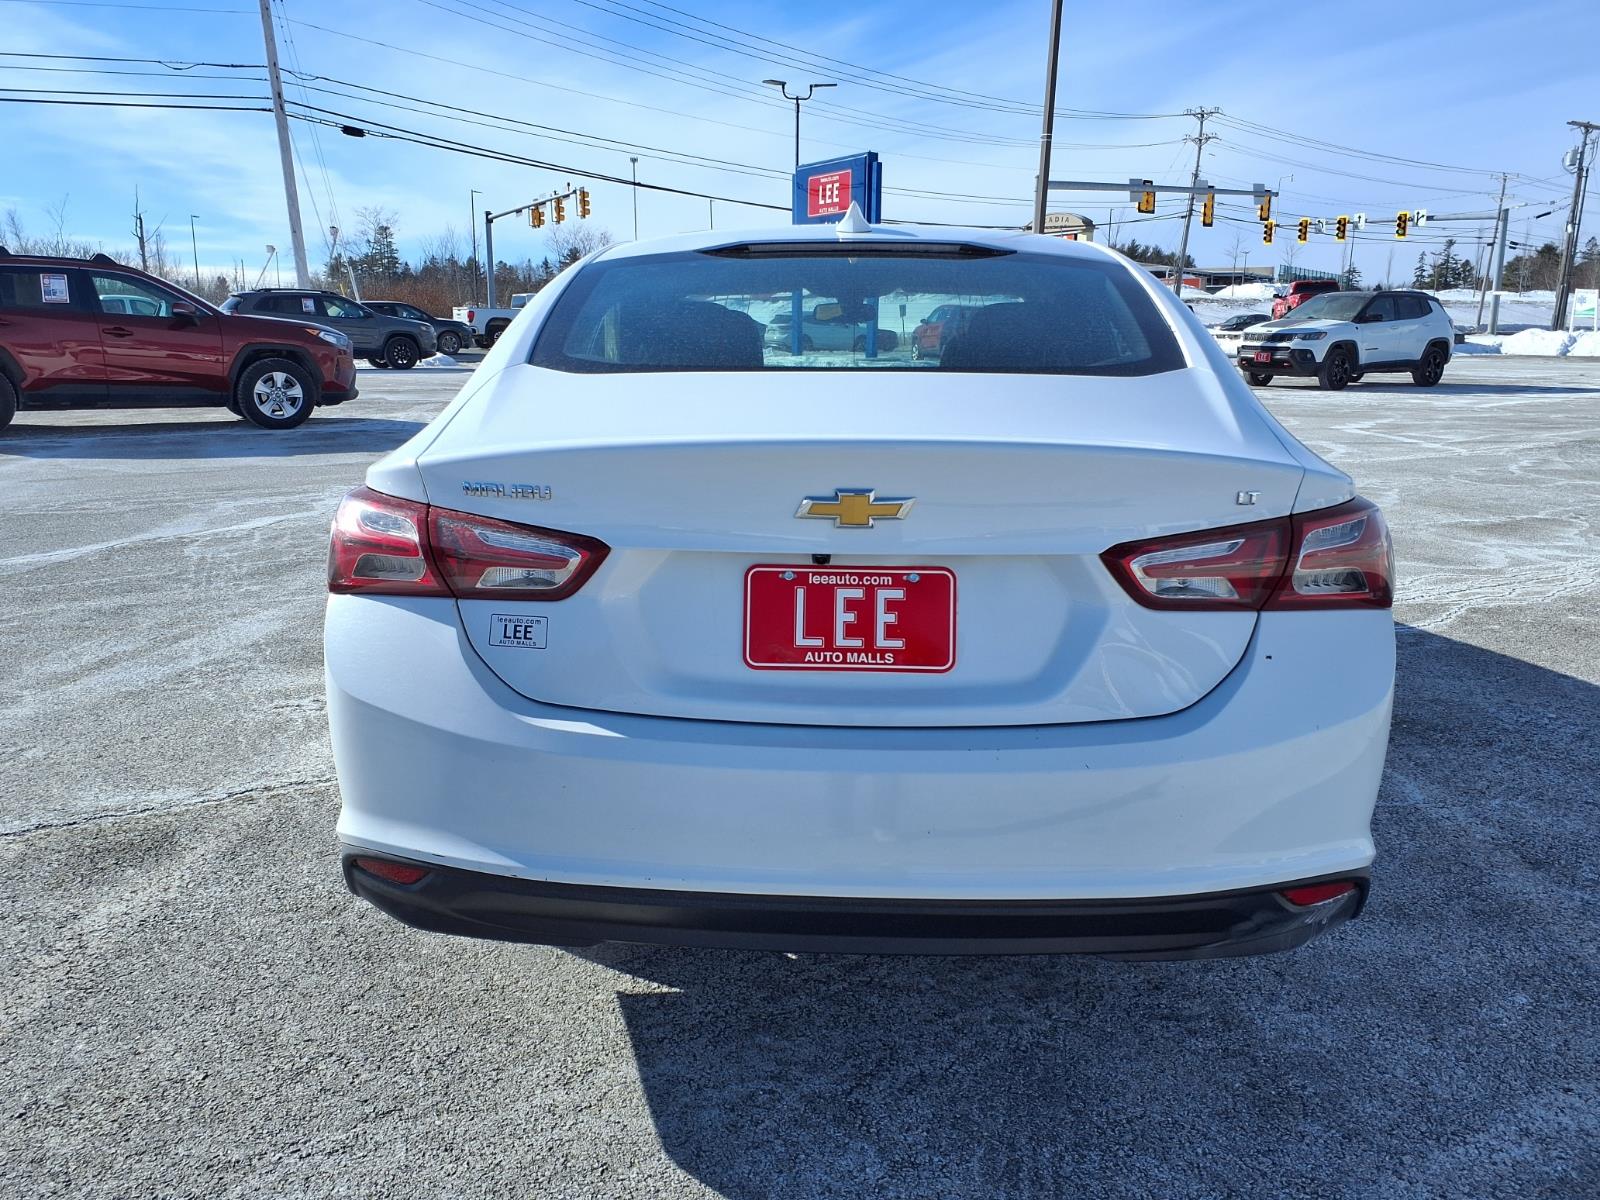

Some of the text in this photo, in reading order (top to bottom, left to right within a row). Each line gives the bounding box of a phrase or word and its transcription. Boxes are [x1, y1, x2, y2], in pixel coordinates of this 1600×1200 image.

[818, 182, 840, 205] LEE
[462, 481, 552, 501] MALIBU
[1235, 490, 1262, 506] LT
[808, 573, 892, 586] leeauto.com
[497, 616, 542, 625] leeauto.com
[793, 586, 907, 649] LEE
[503, 624, 534, 641] LEE
[804, 652, 895, 664] AUTO MALLS
